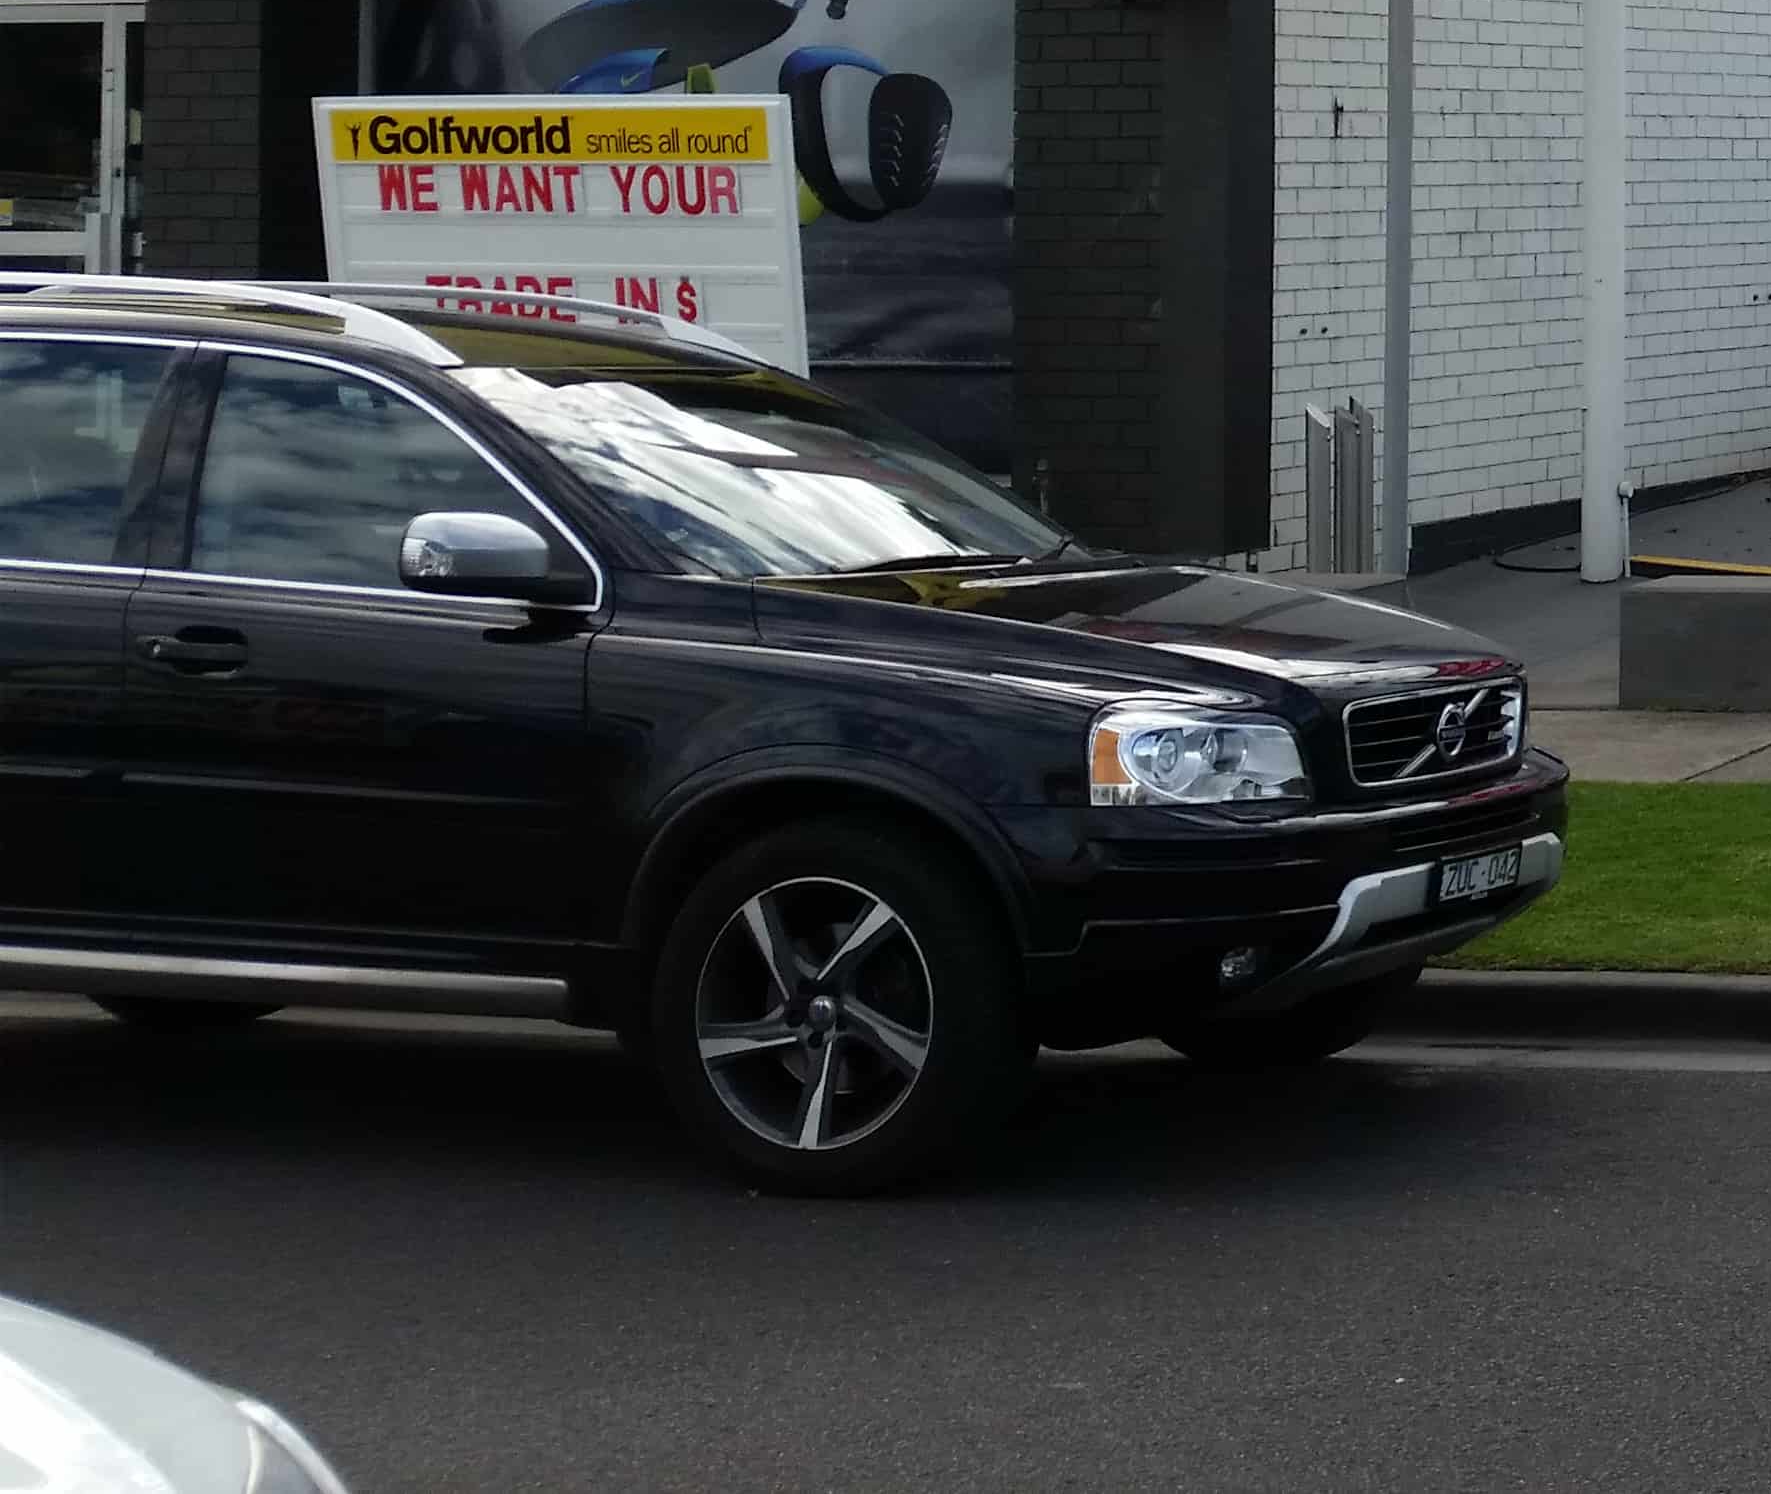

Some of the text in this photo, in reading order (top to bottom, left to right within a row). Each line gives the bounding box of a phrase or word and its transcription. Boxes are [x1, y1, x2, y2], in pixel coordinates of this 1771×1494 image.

[368, 114, 750, 156] Golfworld smiles all round
[378, 163, 740, 215] WE WANT YOUR
[425, 275, 577, 324] TRADE
[614, 277, 659, 324] IN
